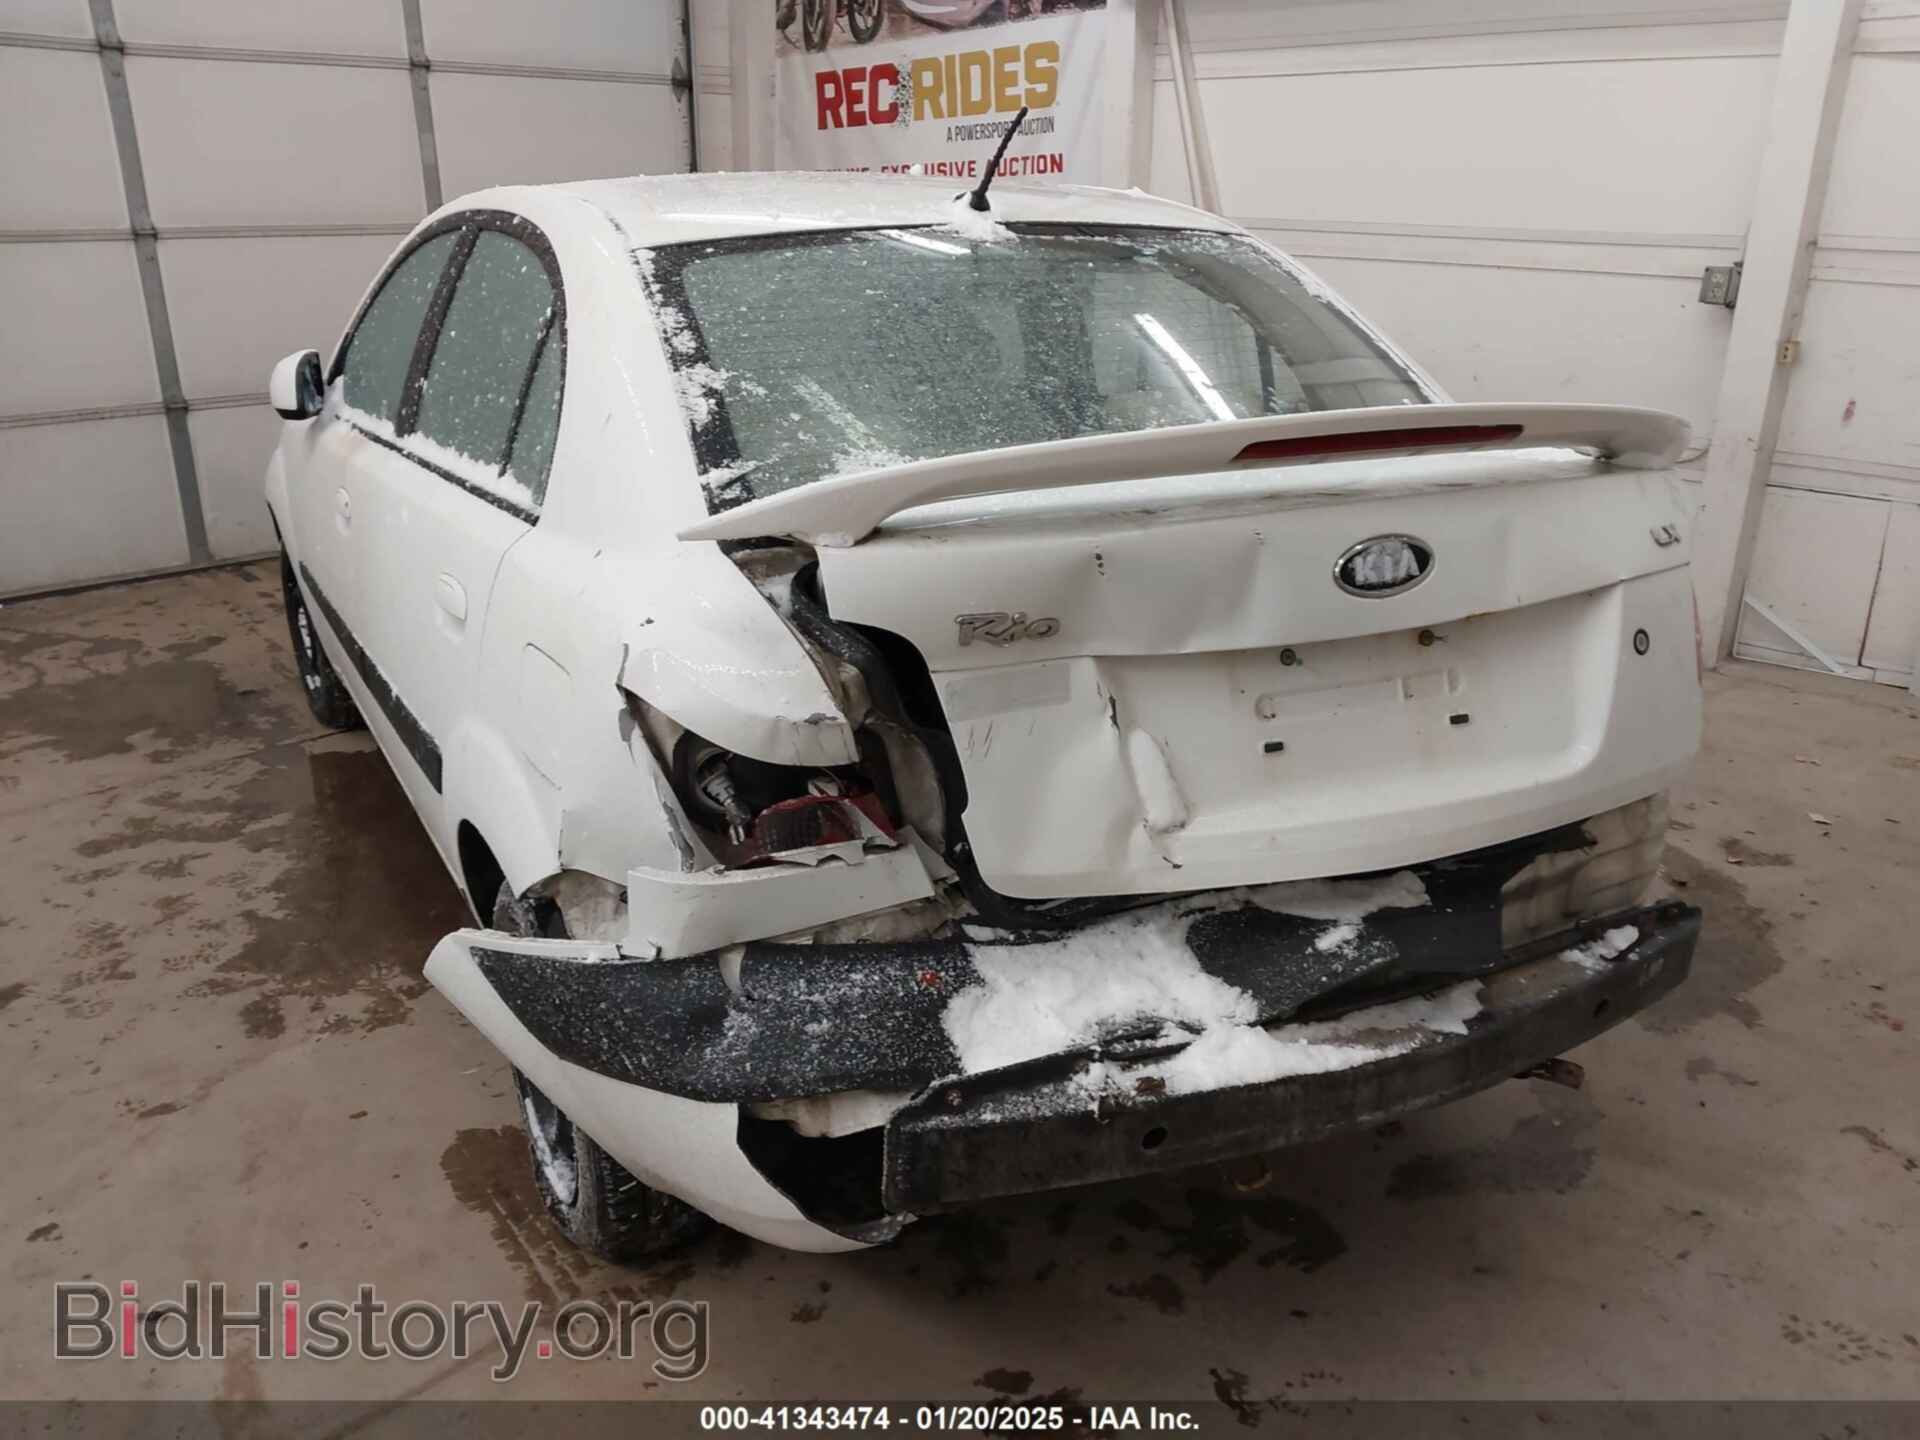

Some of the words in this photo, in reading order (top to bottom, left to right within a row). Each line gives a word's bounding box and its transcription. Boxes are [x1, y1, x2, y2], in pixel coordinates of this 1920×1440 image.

[911, 40, 1061, 122] RIDES
[945, 126, 953, 143] A
[1017, 117, 1055, 137] AUCTION
[1353, 544, 1420, 586] KIA
[954, 611, 1061, 648] Rio
